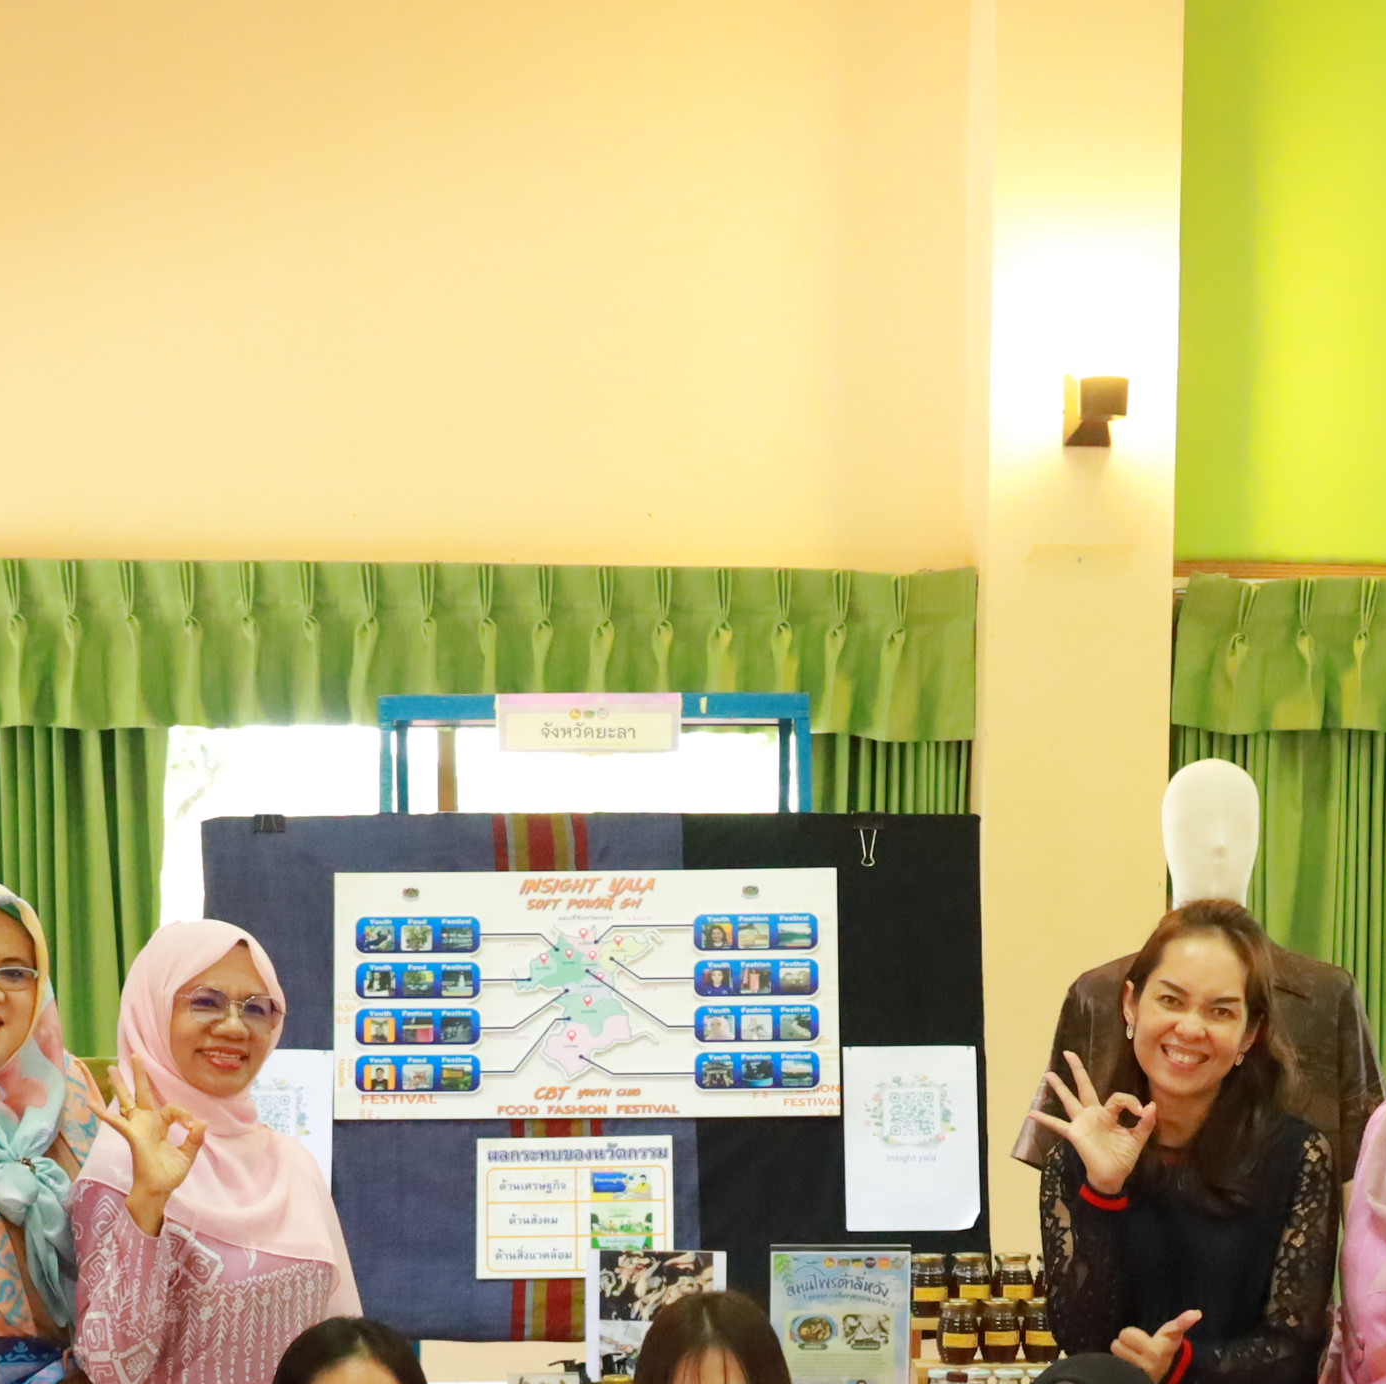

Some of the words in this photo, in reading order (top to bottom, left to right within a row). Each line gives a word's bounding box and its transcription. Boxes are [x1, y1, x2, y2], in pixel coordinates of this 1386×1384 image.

[540, 721, 637, 740] จังหวัดยะลา
[518, 877, 602, 897] INSIGHT
[607, 876, 657, 899] YALA
[525, 898, 563, 911] SOFT
[566, 896, 615, 911] POWER
[360, 1094, 438, 1105] FESTIVAL
[533, 1085, 571, 1101] CBT
[497, 1104, 539, 1115] FOOD
[547, 1104, 608, 1115] FASHION
[616, 1104, 680, 1114] FESTIVAL
[487, 1142, 669, 1163] ผลกระทบของนวัตกรรม
[886, 1153, 916, 1163] Insight
[919, 1153, 937, 1163] yala
[499, 1179, 567, 1194] ด้านเศรษฐกิจ
[508, 1213, 559, 1225] ด้านสังคม
[495, 1246, 573, 1261] ด้านสิ่งแวดล้อม
